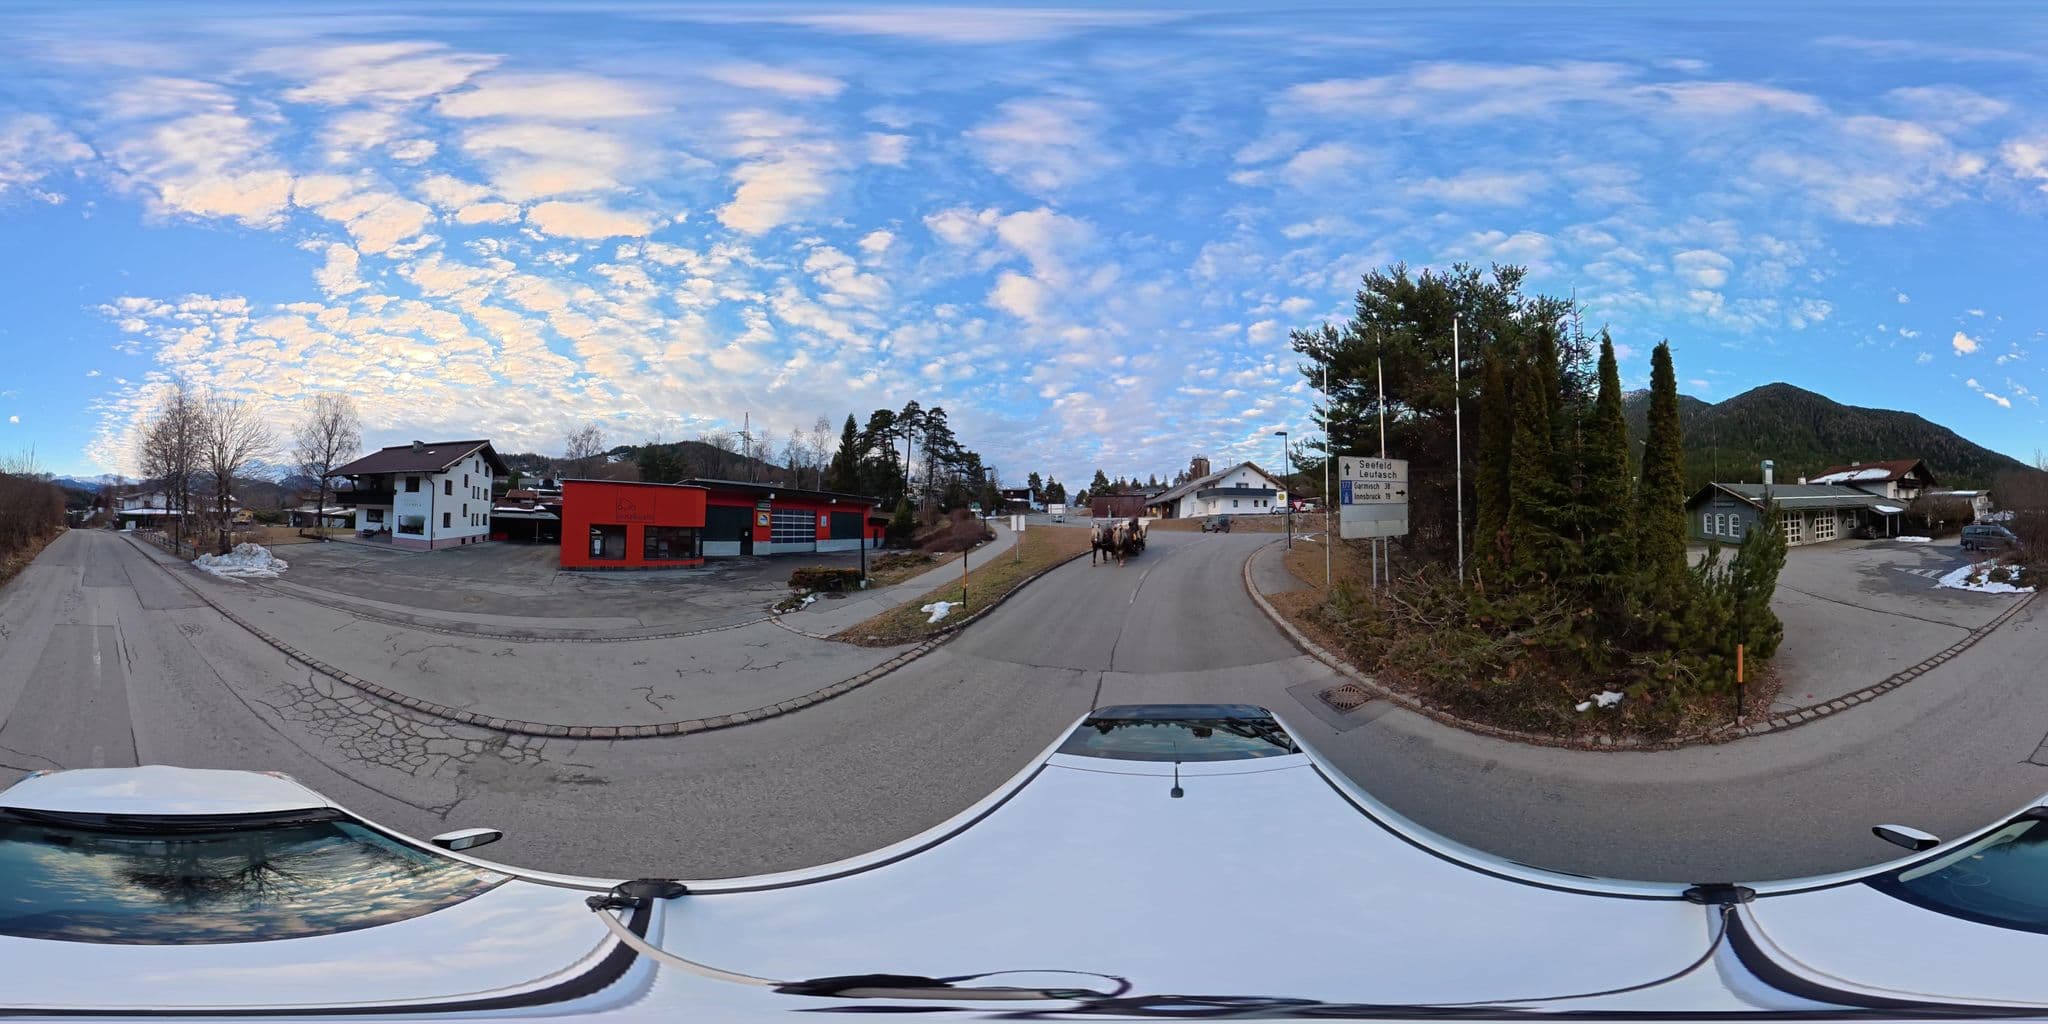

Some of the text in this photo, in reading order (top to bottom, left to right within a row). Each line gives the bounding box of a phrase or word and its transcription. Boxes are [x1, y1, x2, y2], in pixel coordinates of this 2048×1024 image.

[1359, 460, 1392, 470] Seefeld
[1359, 470, 1397, 479] Leutasch
[1354, 482, 1380, 490] Garmisch
[1354, 492, 1381, 500] Innsbruck
